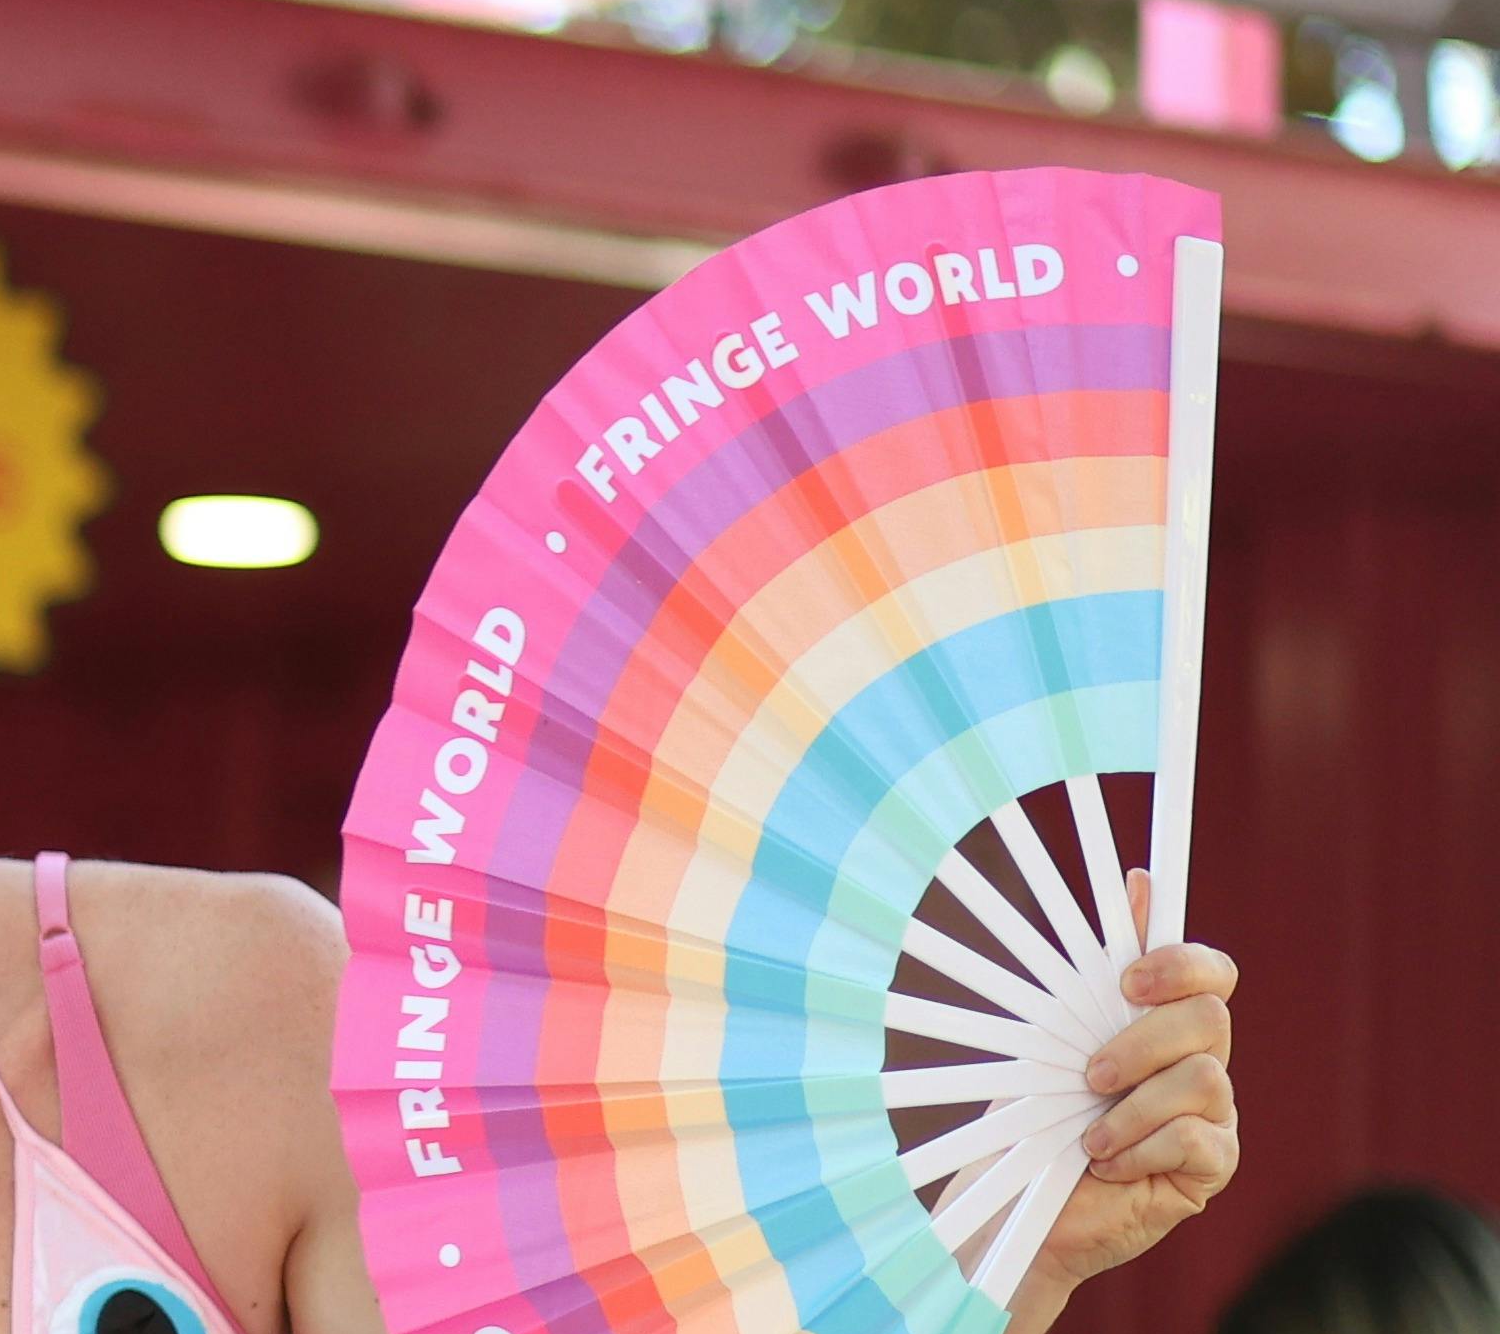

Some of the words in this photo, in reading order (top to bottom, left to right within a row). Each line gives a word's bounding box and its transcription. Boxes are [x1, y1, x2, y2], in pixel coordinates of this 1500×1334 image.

[574, 312, 800, 503] FRINGE
[804, 243, 1064, 339] WORLD
[405, 605, 527, 866] WORLD
[393, 893, 463, 1179] FRINGE
